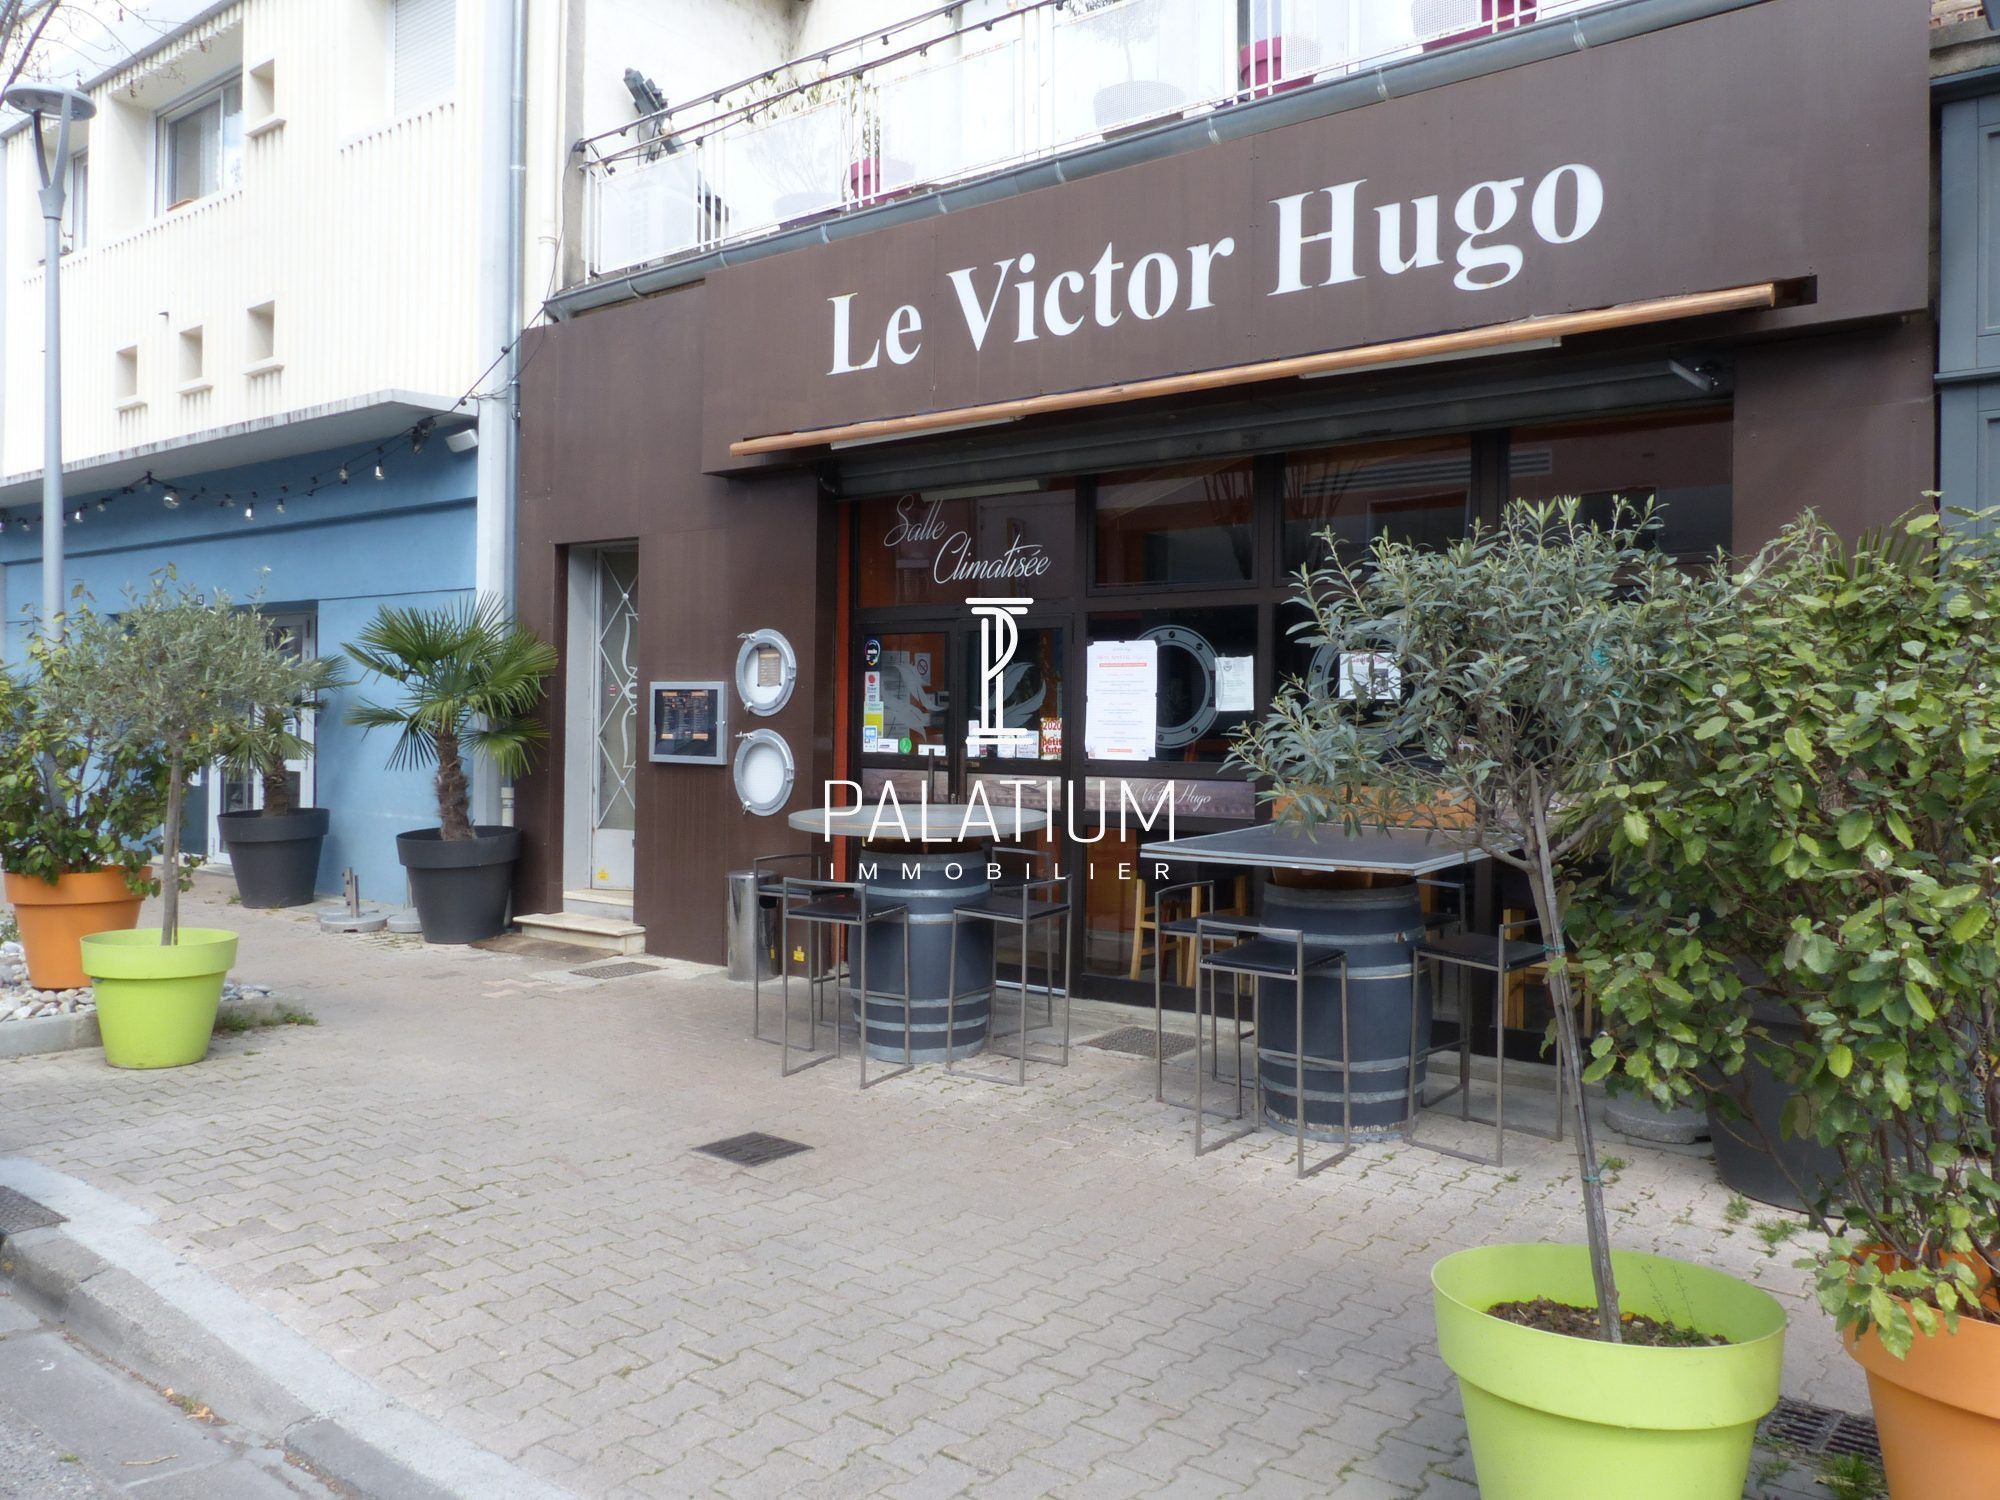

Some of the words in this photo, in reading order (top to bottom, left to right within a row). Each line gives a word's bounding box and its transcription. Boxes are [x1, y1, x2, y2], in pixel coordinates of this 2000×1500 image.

[826, 292, 922, 376] Le
[945, 236, 1235, 352] Victor
[1266, 163, 1604, 297] Hugo
[884, 494, 947, 547] Salle
[933, 530, 1051, 584] Climatisée
